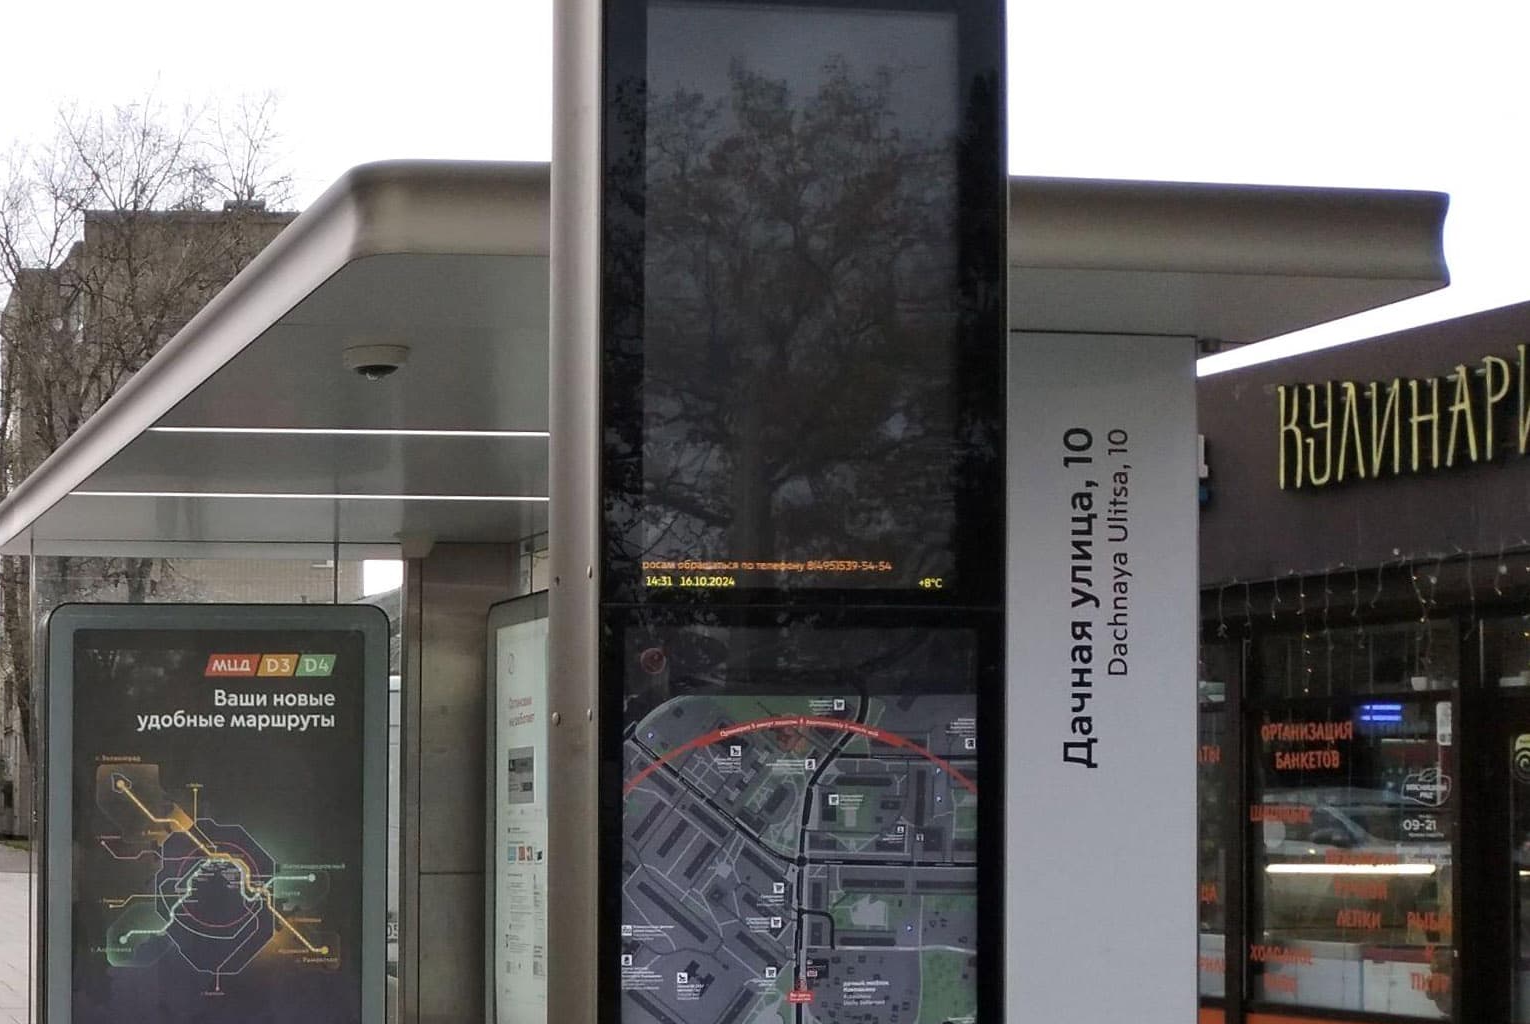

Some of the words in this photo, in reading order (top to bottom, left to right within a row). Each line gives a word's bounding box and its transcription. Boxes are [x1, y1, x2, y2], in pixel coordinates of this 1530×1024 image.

[1063, 427, 1093, 468] 10
[1108, 428, 1129, 456] 10
[1107, 463, 1131, 543] Ulitsa,
[1070, 480, 1100, 609] улица,
[646, 576, 673, 587] 14:31
[680, 576, 736, 587] 16.10.2024
[1107, 551, 1132, 677] Dachnaya
[212, 659, 252, 672] МЦД
[214, 689, 268, 707] Ваши
[273, 693, 336, 707] новые
[1063, 620, 1098, 769] Дачная
[137, 710, 225, 732] удобные
[230, 713, 335, 732] маршруты
[1261, 721, 1354, 742] ОРГАНИЗАЦИЯ
[1275, 750, 1340, 770] БАНКЕТОВ
[1403, 819, 1438, 832] 09-21
